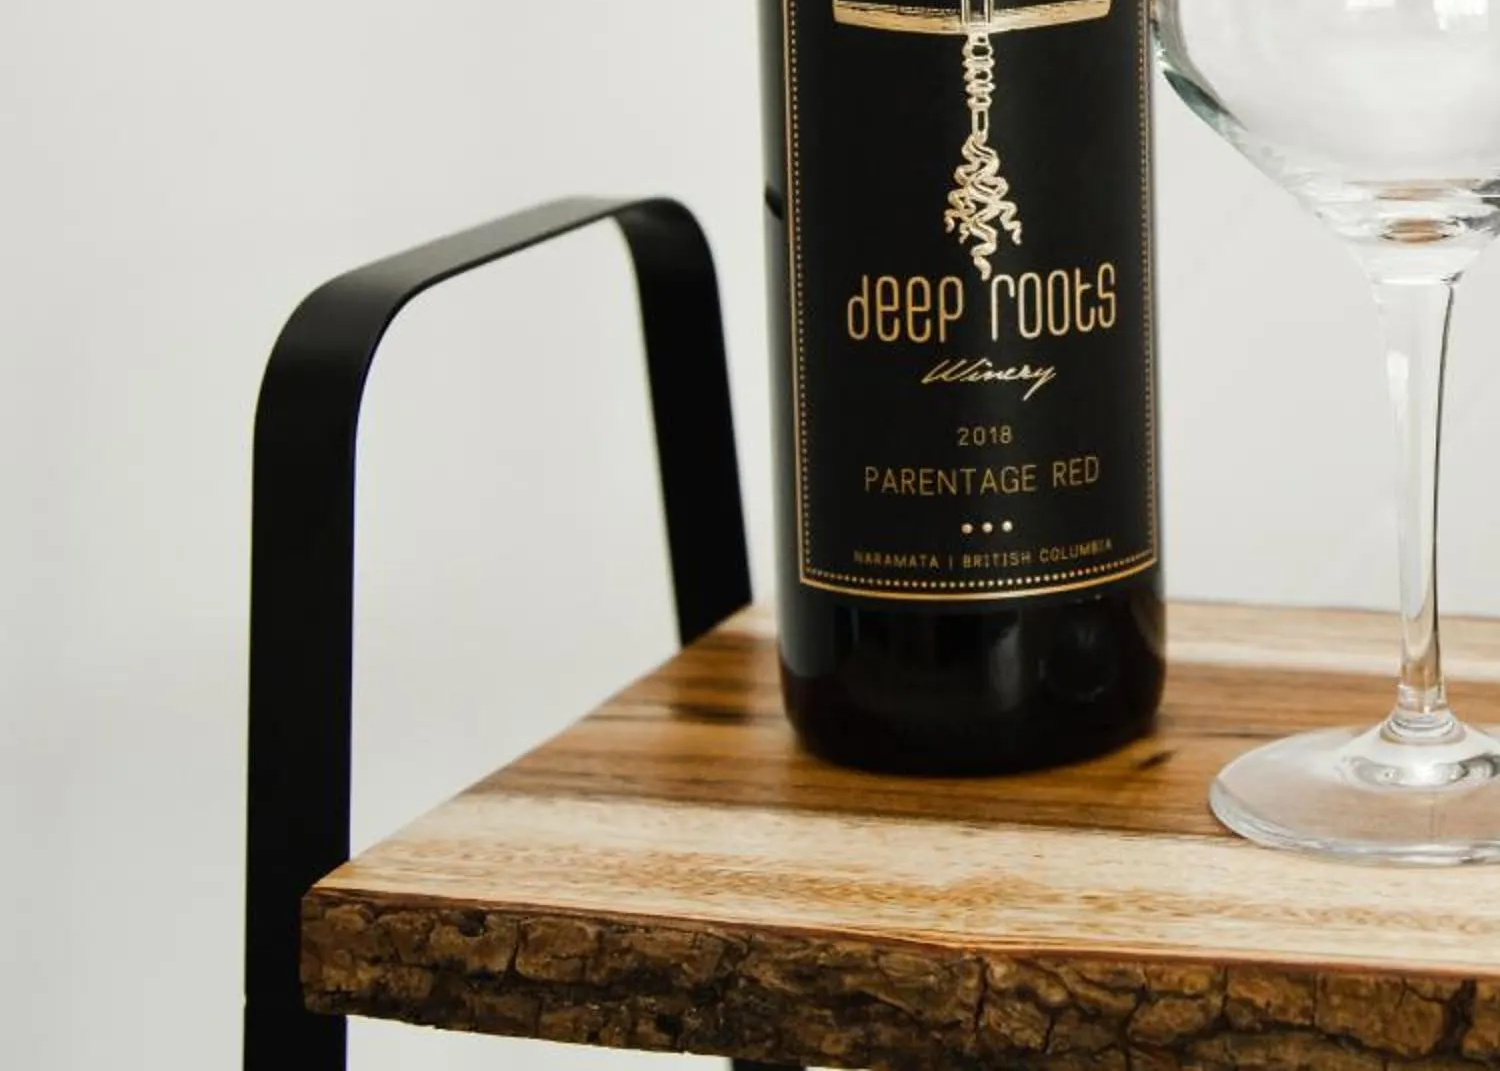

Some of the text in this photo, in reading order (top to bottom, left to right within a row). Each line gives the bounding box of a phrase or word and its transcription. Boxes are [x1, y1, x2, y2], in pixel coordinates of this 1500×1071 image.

[847, 262, 1116, 343] deep roots
[920, 357, 1057, 402] Winery
[957, 425, 1013, 446] 2018
[864, 456, 1100, 496] PARENTAGE RED
[853, 538, 1112, 569] NARAMATA BRITISH COLUMBIA
